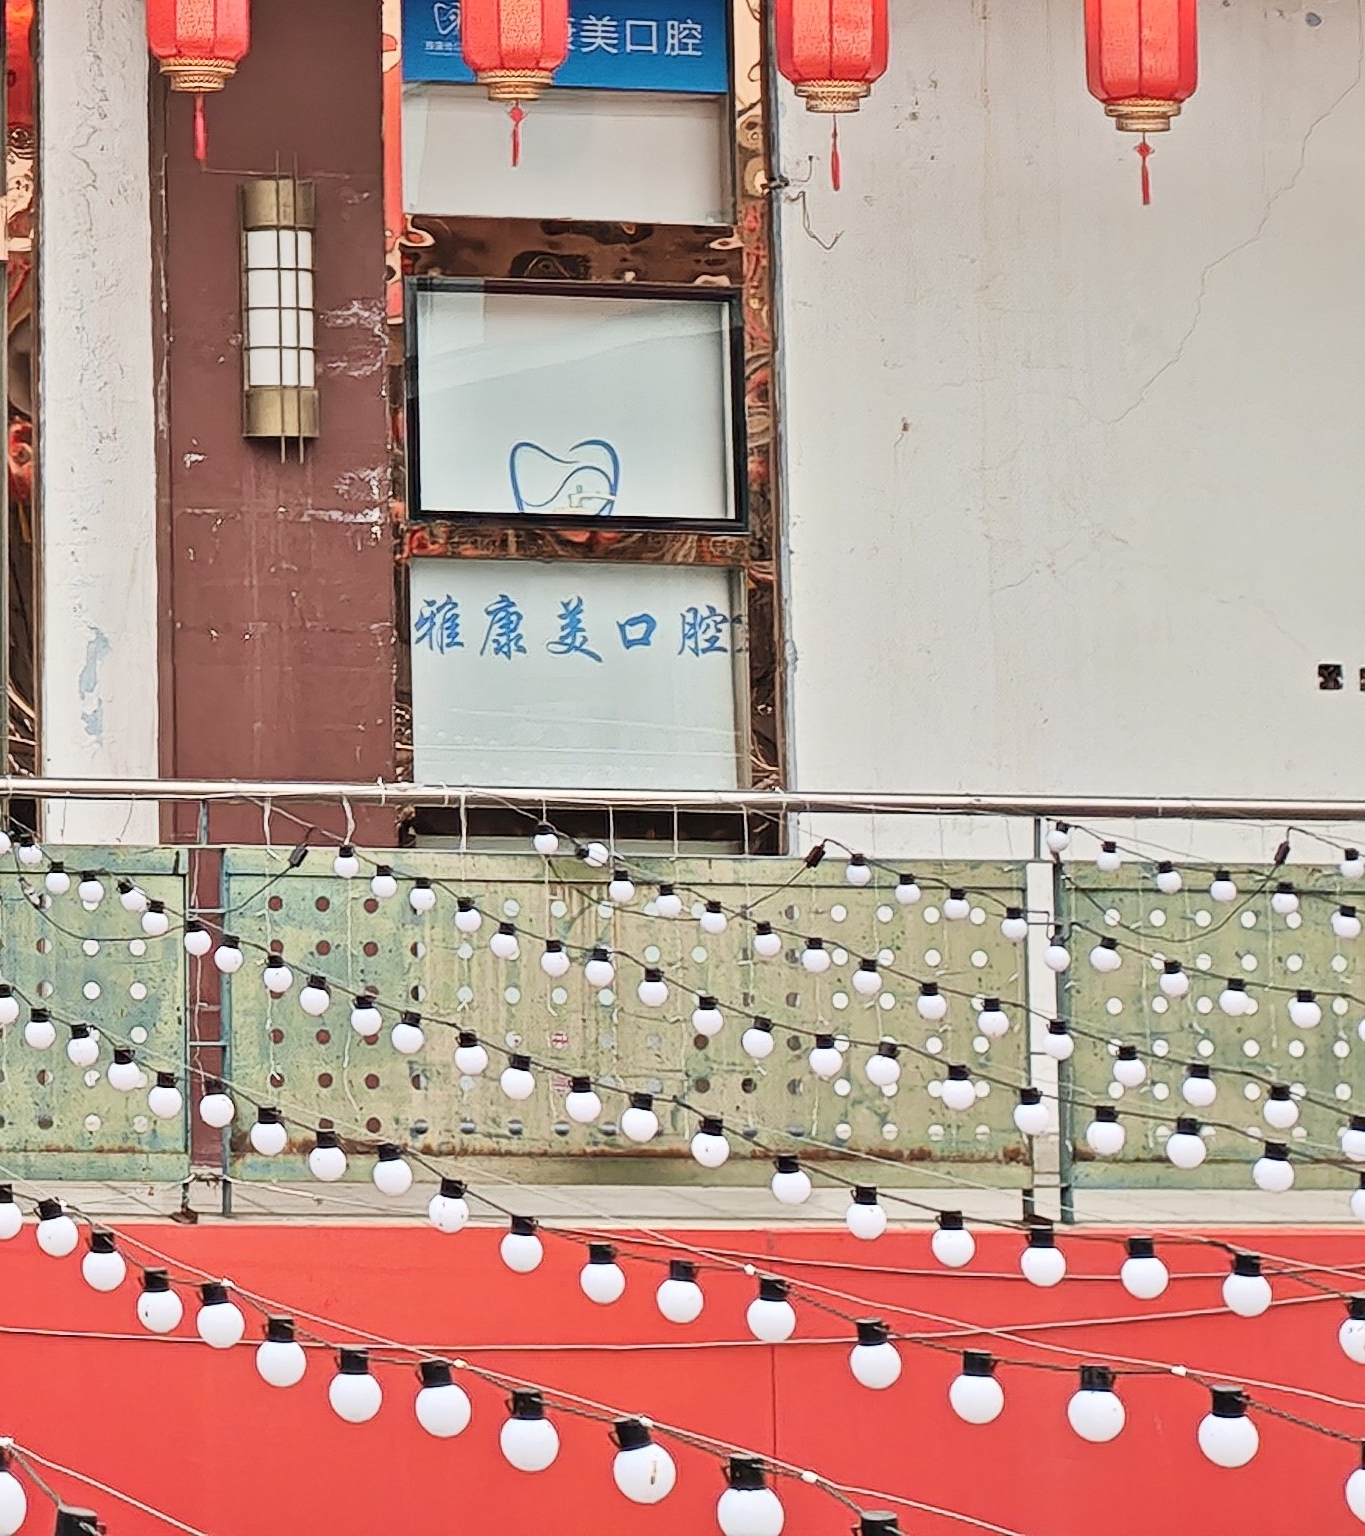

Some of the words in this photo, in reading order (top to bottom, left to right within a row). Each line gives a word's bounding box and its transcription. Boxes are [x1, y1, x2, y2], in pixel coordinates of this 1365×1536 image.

[569, 15, 704, 58] 美口腔
[414, 594, 745, 663] 雅康美口腔
